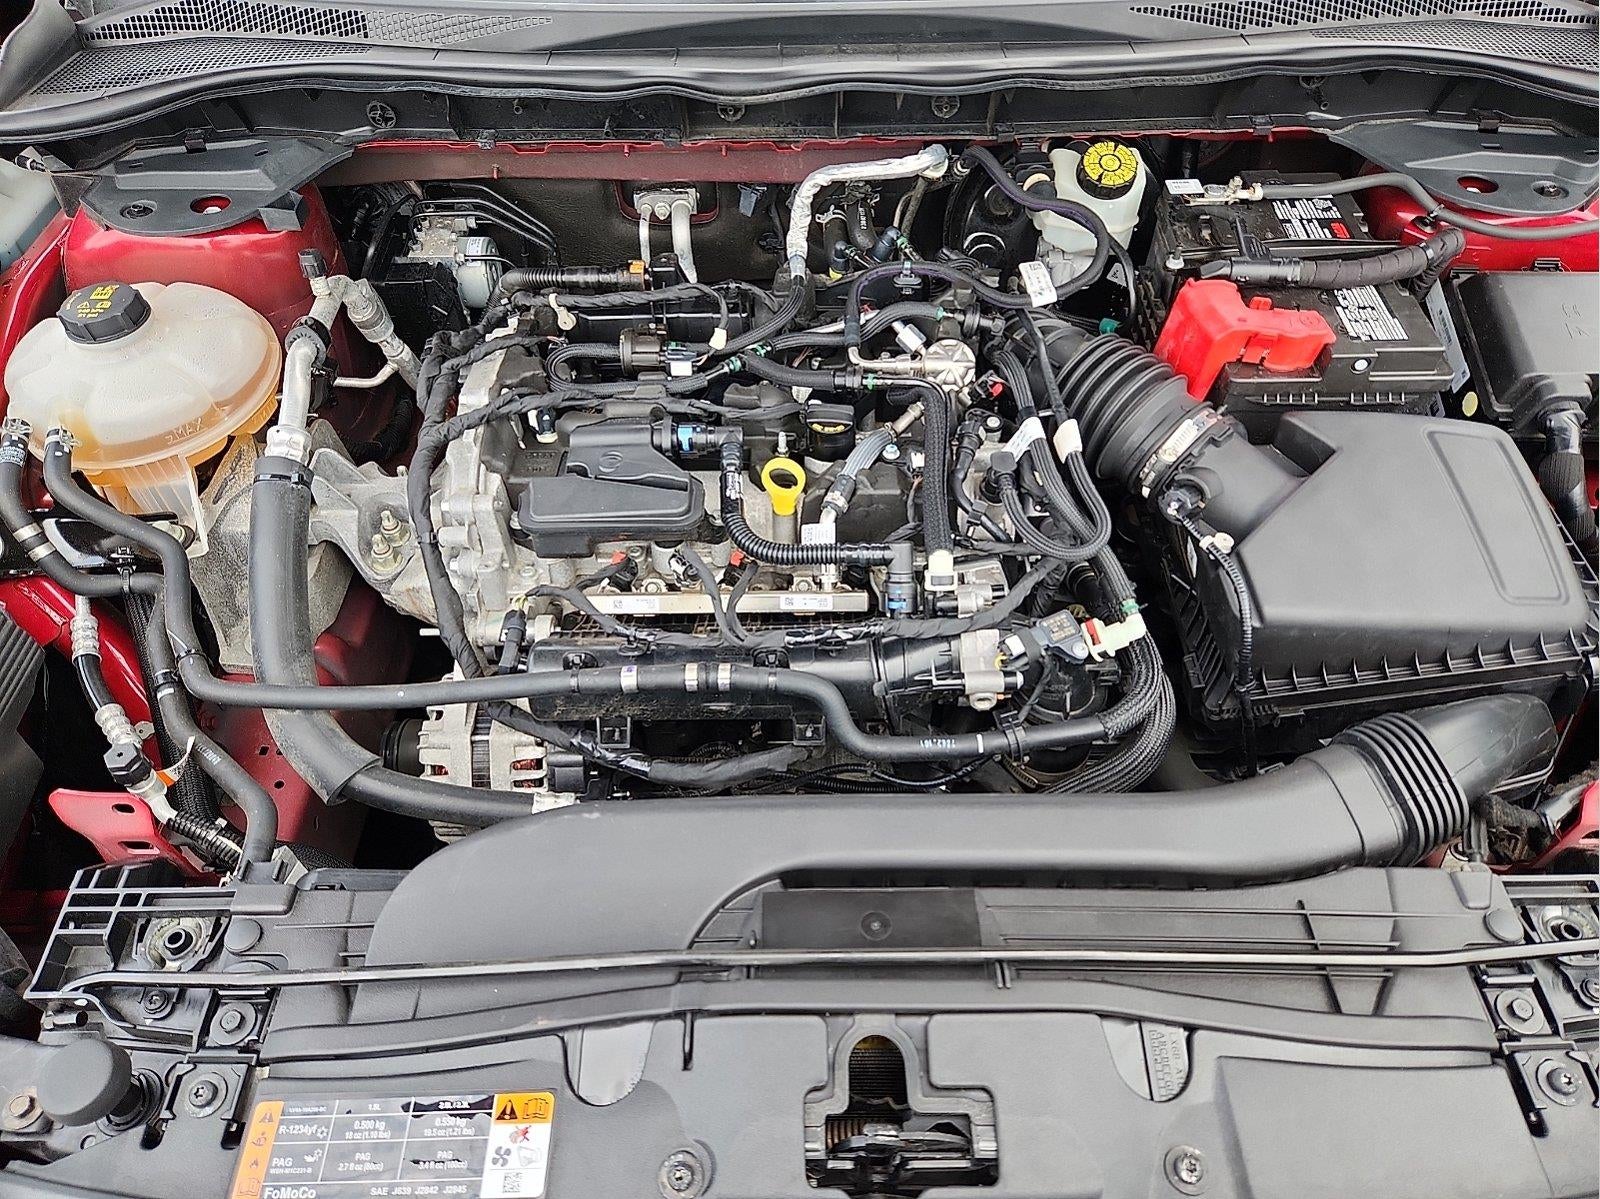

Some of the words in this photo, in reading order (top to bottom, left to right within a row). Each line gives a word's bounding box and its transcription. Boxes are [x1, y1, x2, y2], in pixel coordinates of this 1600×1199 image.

[173, 417, 202, 439] MAX
[353, 1120, 375, 1130] 0.500
[375, 1120, 386, 1131] kg
[456, 1118, 467, 1128] kg
[278, 1124, 317, 1136] R-1234yf
[354, 1152, 371, 1161] PAG
[436, 1150, 453, 1159] PAG
[271, 1157, 293, 1167] PAG
[264, 1186, 317, 1199] FoMoCo
[370, 1187, 389, 1196] SAE
